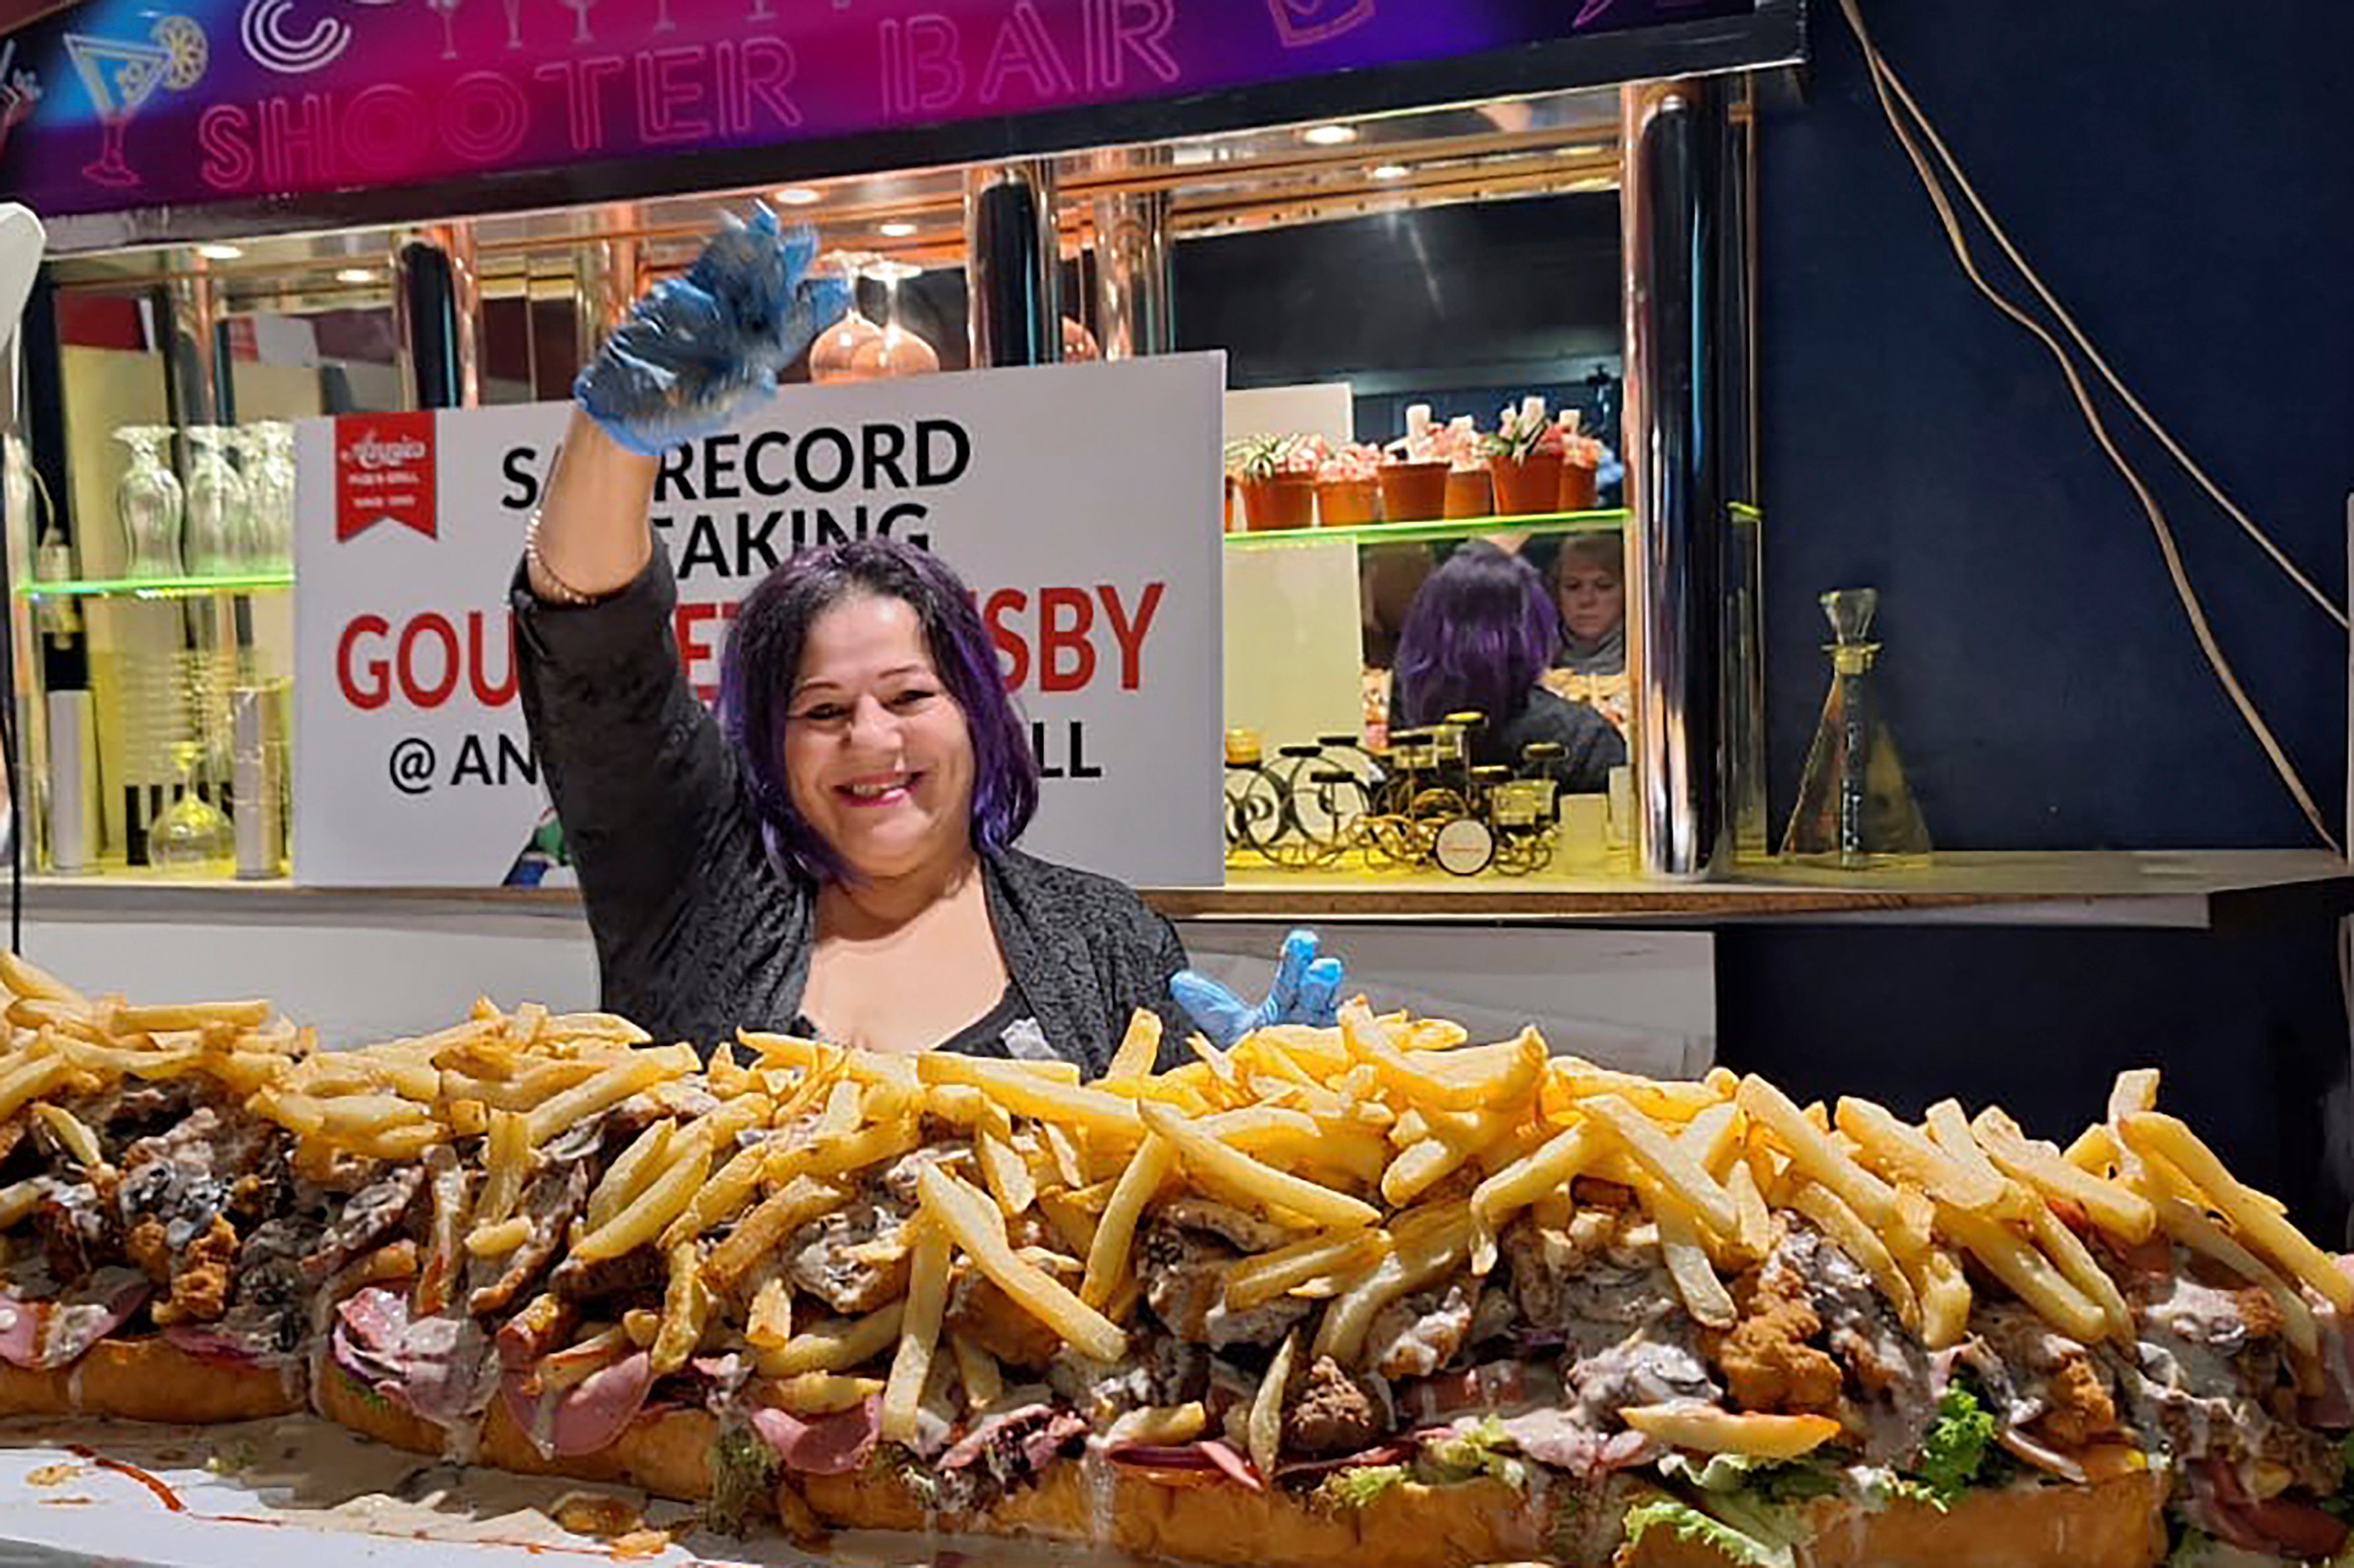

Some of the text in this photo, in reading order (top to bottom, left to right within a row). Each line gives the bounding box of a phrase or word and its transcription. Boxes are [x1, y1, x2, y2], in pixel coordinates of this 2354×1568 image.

[198, 36, 803, 189] SHOOTER
[878, 0, 1180, 121] BAR
[655, 419, 971, 501] RECORD
[652, 503, 929, 579] AKING
[965, 583, 1165, 692] SBY
[390, 738, 435, 794] @
